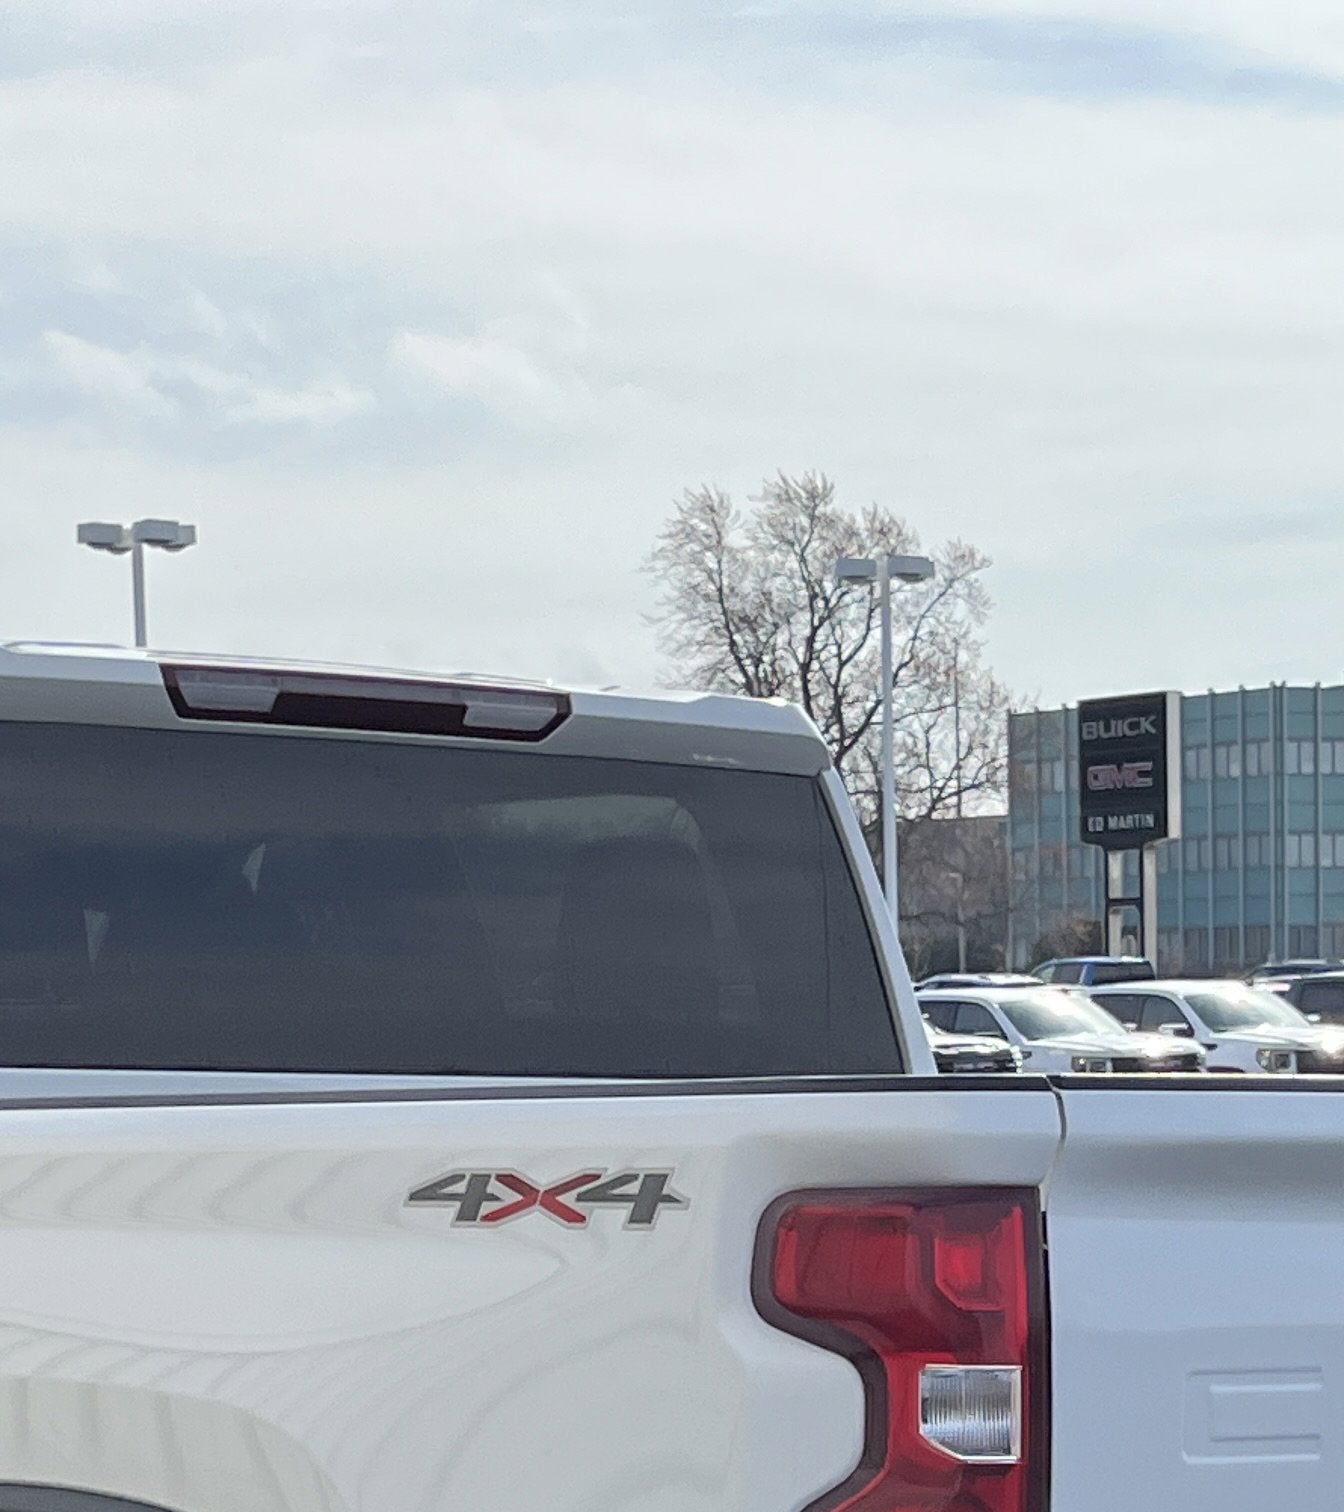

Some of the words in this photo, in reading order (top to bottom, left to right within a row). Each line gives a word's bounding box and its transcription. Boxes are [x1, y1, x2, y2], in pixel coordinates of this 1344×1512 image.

[1082, 715, 1156, 740] BUICK
[1087, 761, 1153, 790] GMC
[1108, 813, 1154, 831] MARTIN
